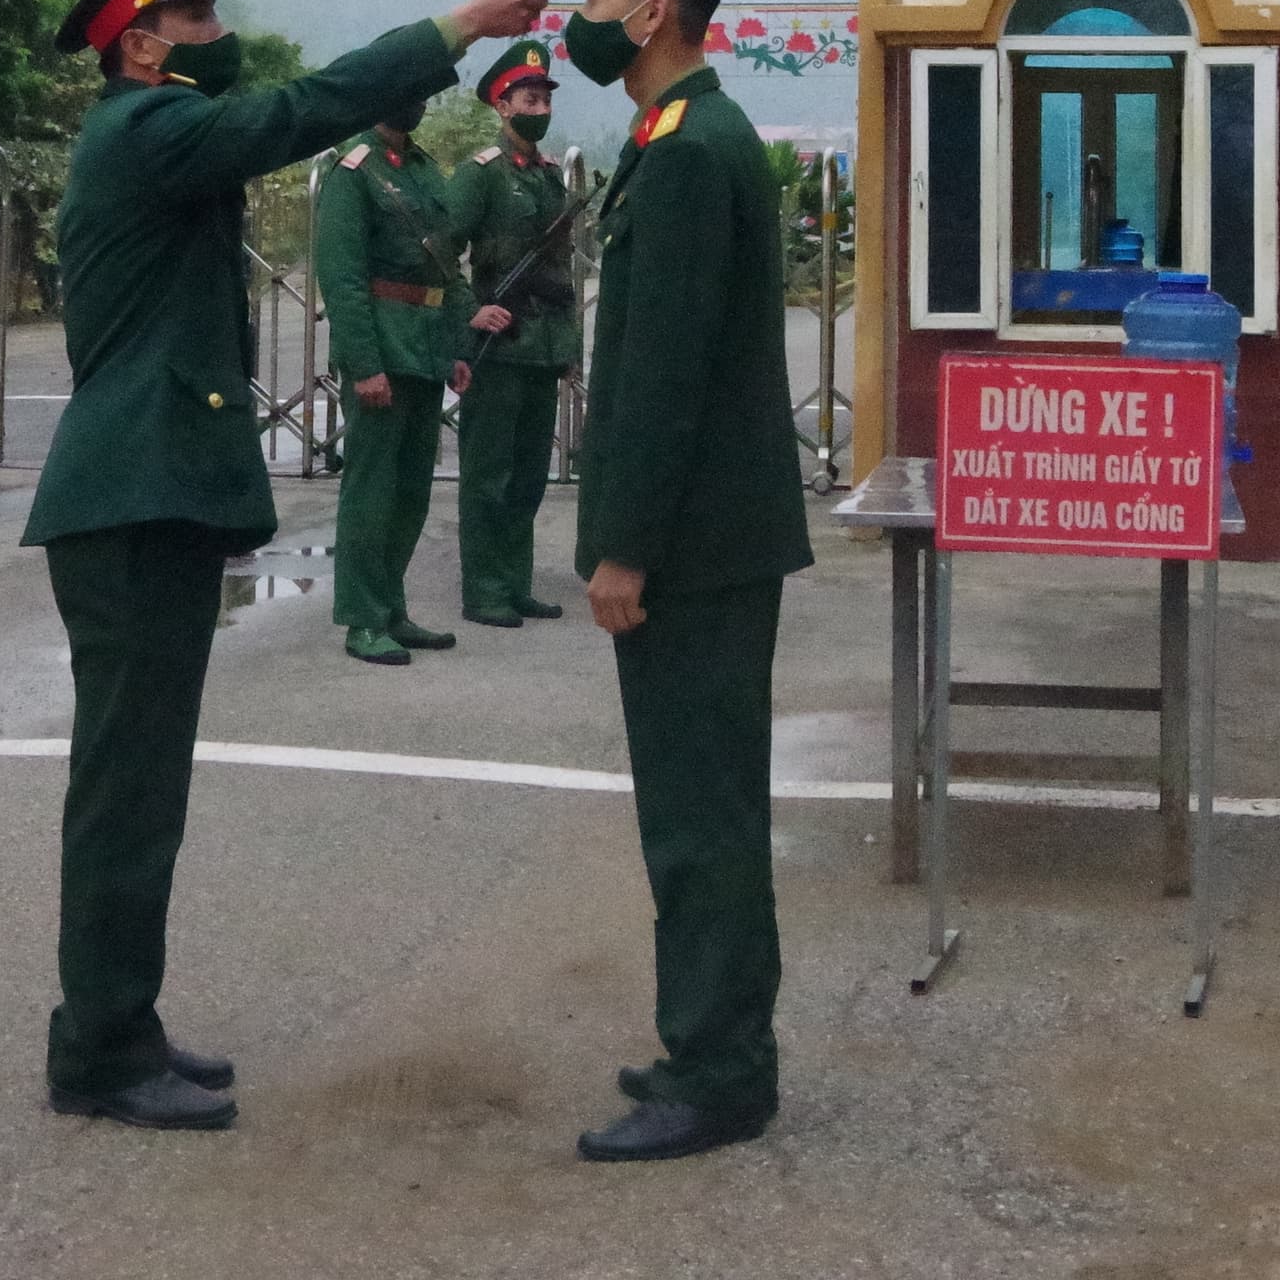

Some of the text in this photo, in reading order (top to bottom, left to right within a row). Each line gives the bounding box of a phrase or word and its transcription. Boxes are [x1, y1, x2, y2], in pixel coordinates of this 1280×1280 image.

[981, 376, 1085, 434] DỪNG
[1099, 392, 1146, 436] XE
[952, 442, 1201, 486] XUẤT TRÌNH GIẤY TỜ
[964, 489, 1184, 533] DẮT XE QUA CỔNG
